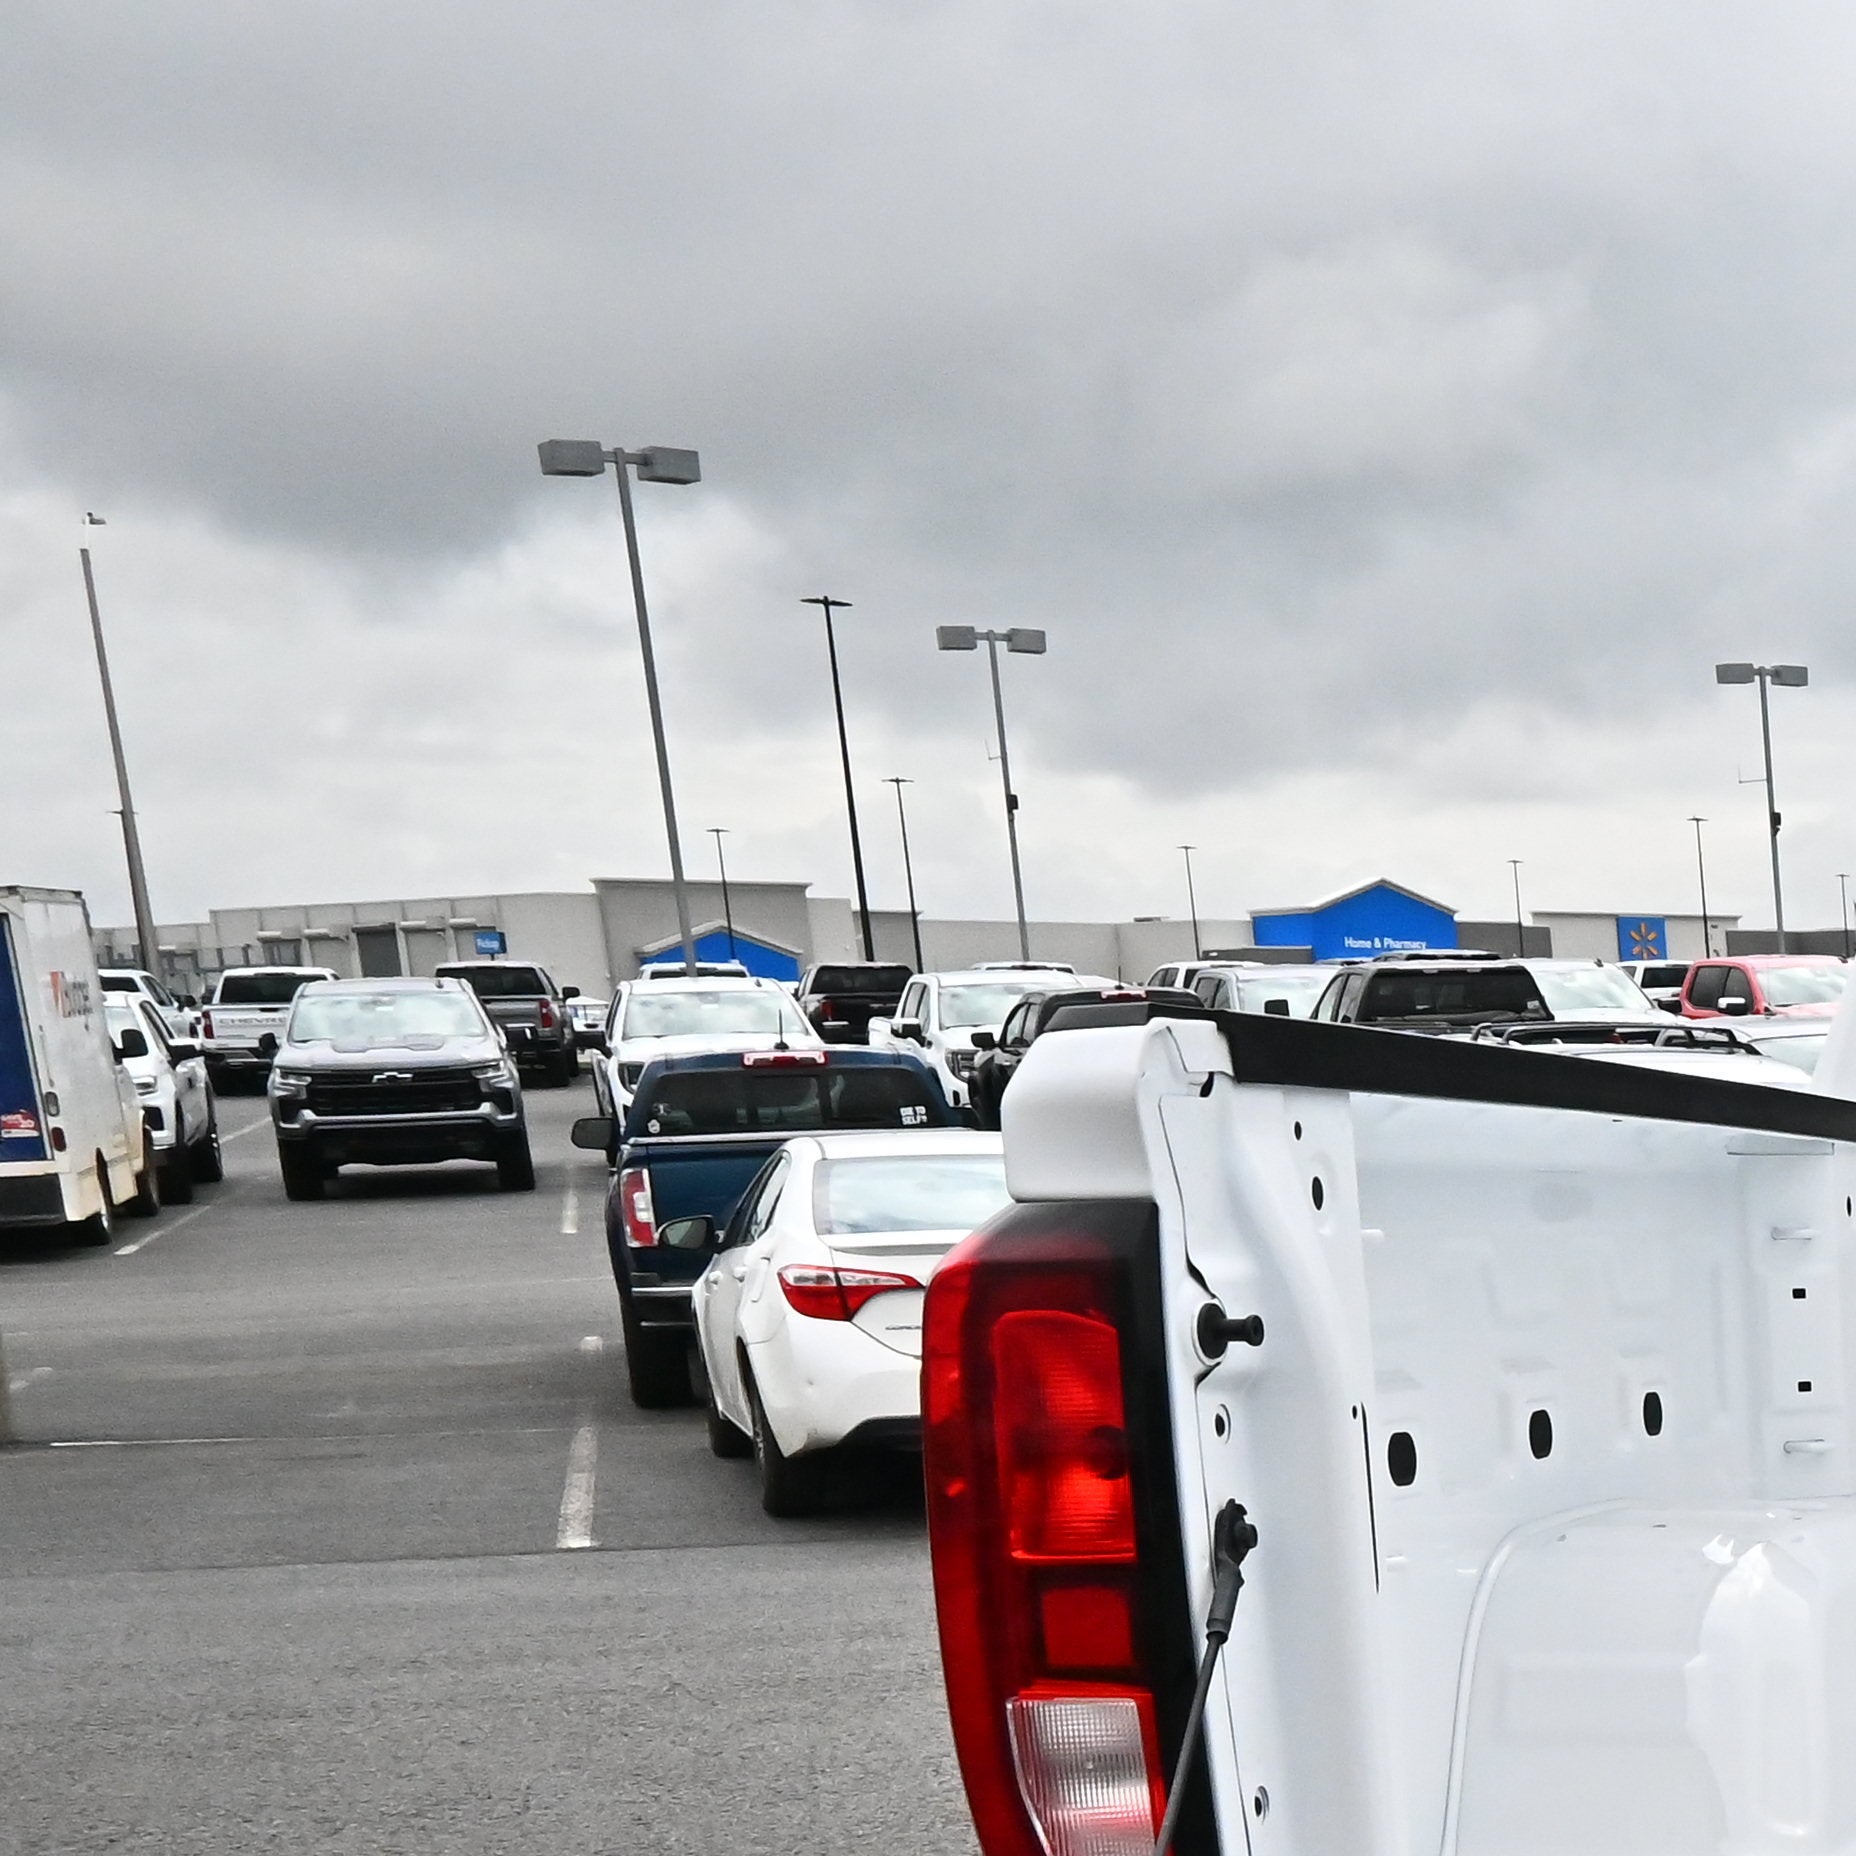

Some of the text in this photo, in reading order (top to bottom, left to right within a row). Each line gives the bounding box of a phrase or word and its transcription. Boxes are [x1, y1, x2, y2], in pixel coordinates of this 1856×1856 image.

[1344, 936, 1427, 950] Home & Pharmacy
